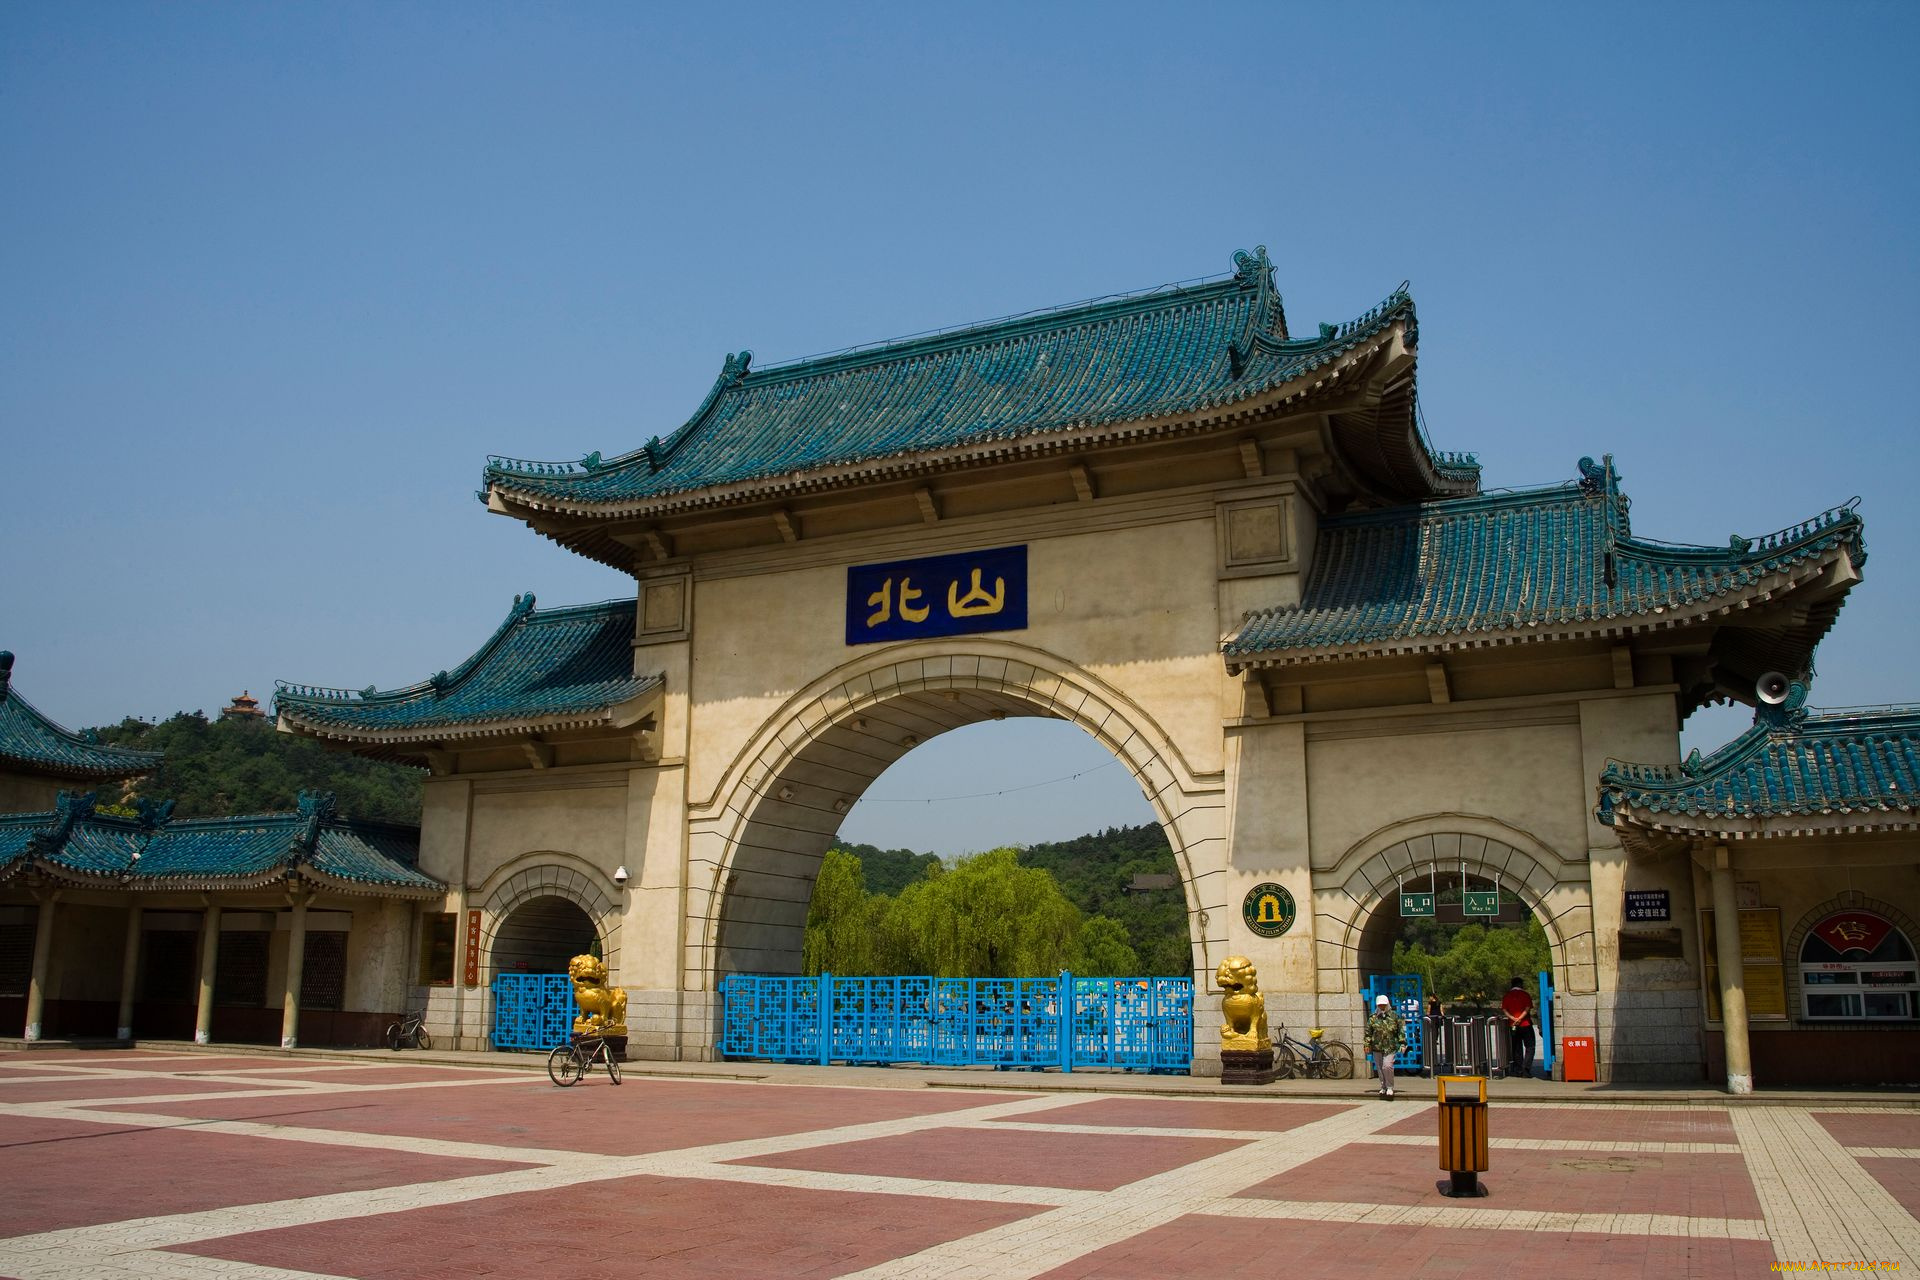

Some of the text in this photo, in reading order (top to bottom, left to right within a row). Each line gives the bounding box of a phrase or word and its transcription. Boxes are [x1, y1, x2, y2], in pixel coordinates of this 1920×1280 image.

[866, 567, 1006, 629] 北山
[1404, 897, 1431, 908] 出口
[1468, 896, 1495, 907] 入口
[1629, 908, 1667, 918] 公安值班室
